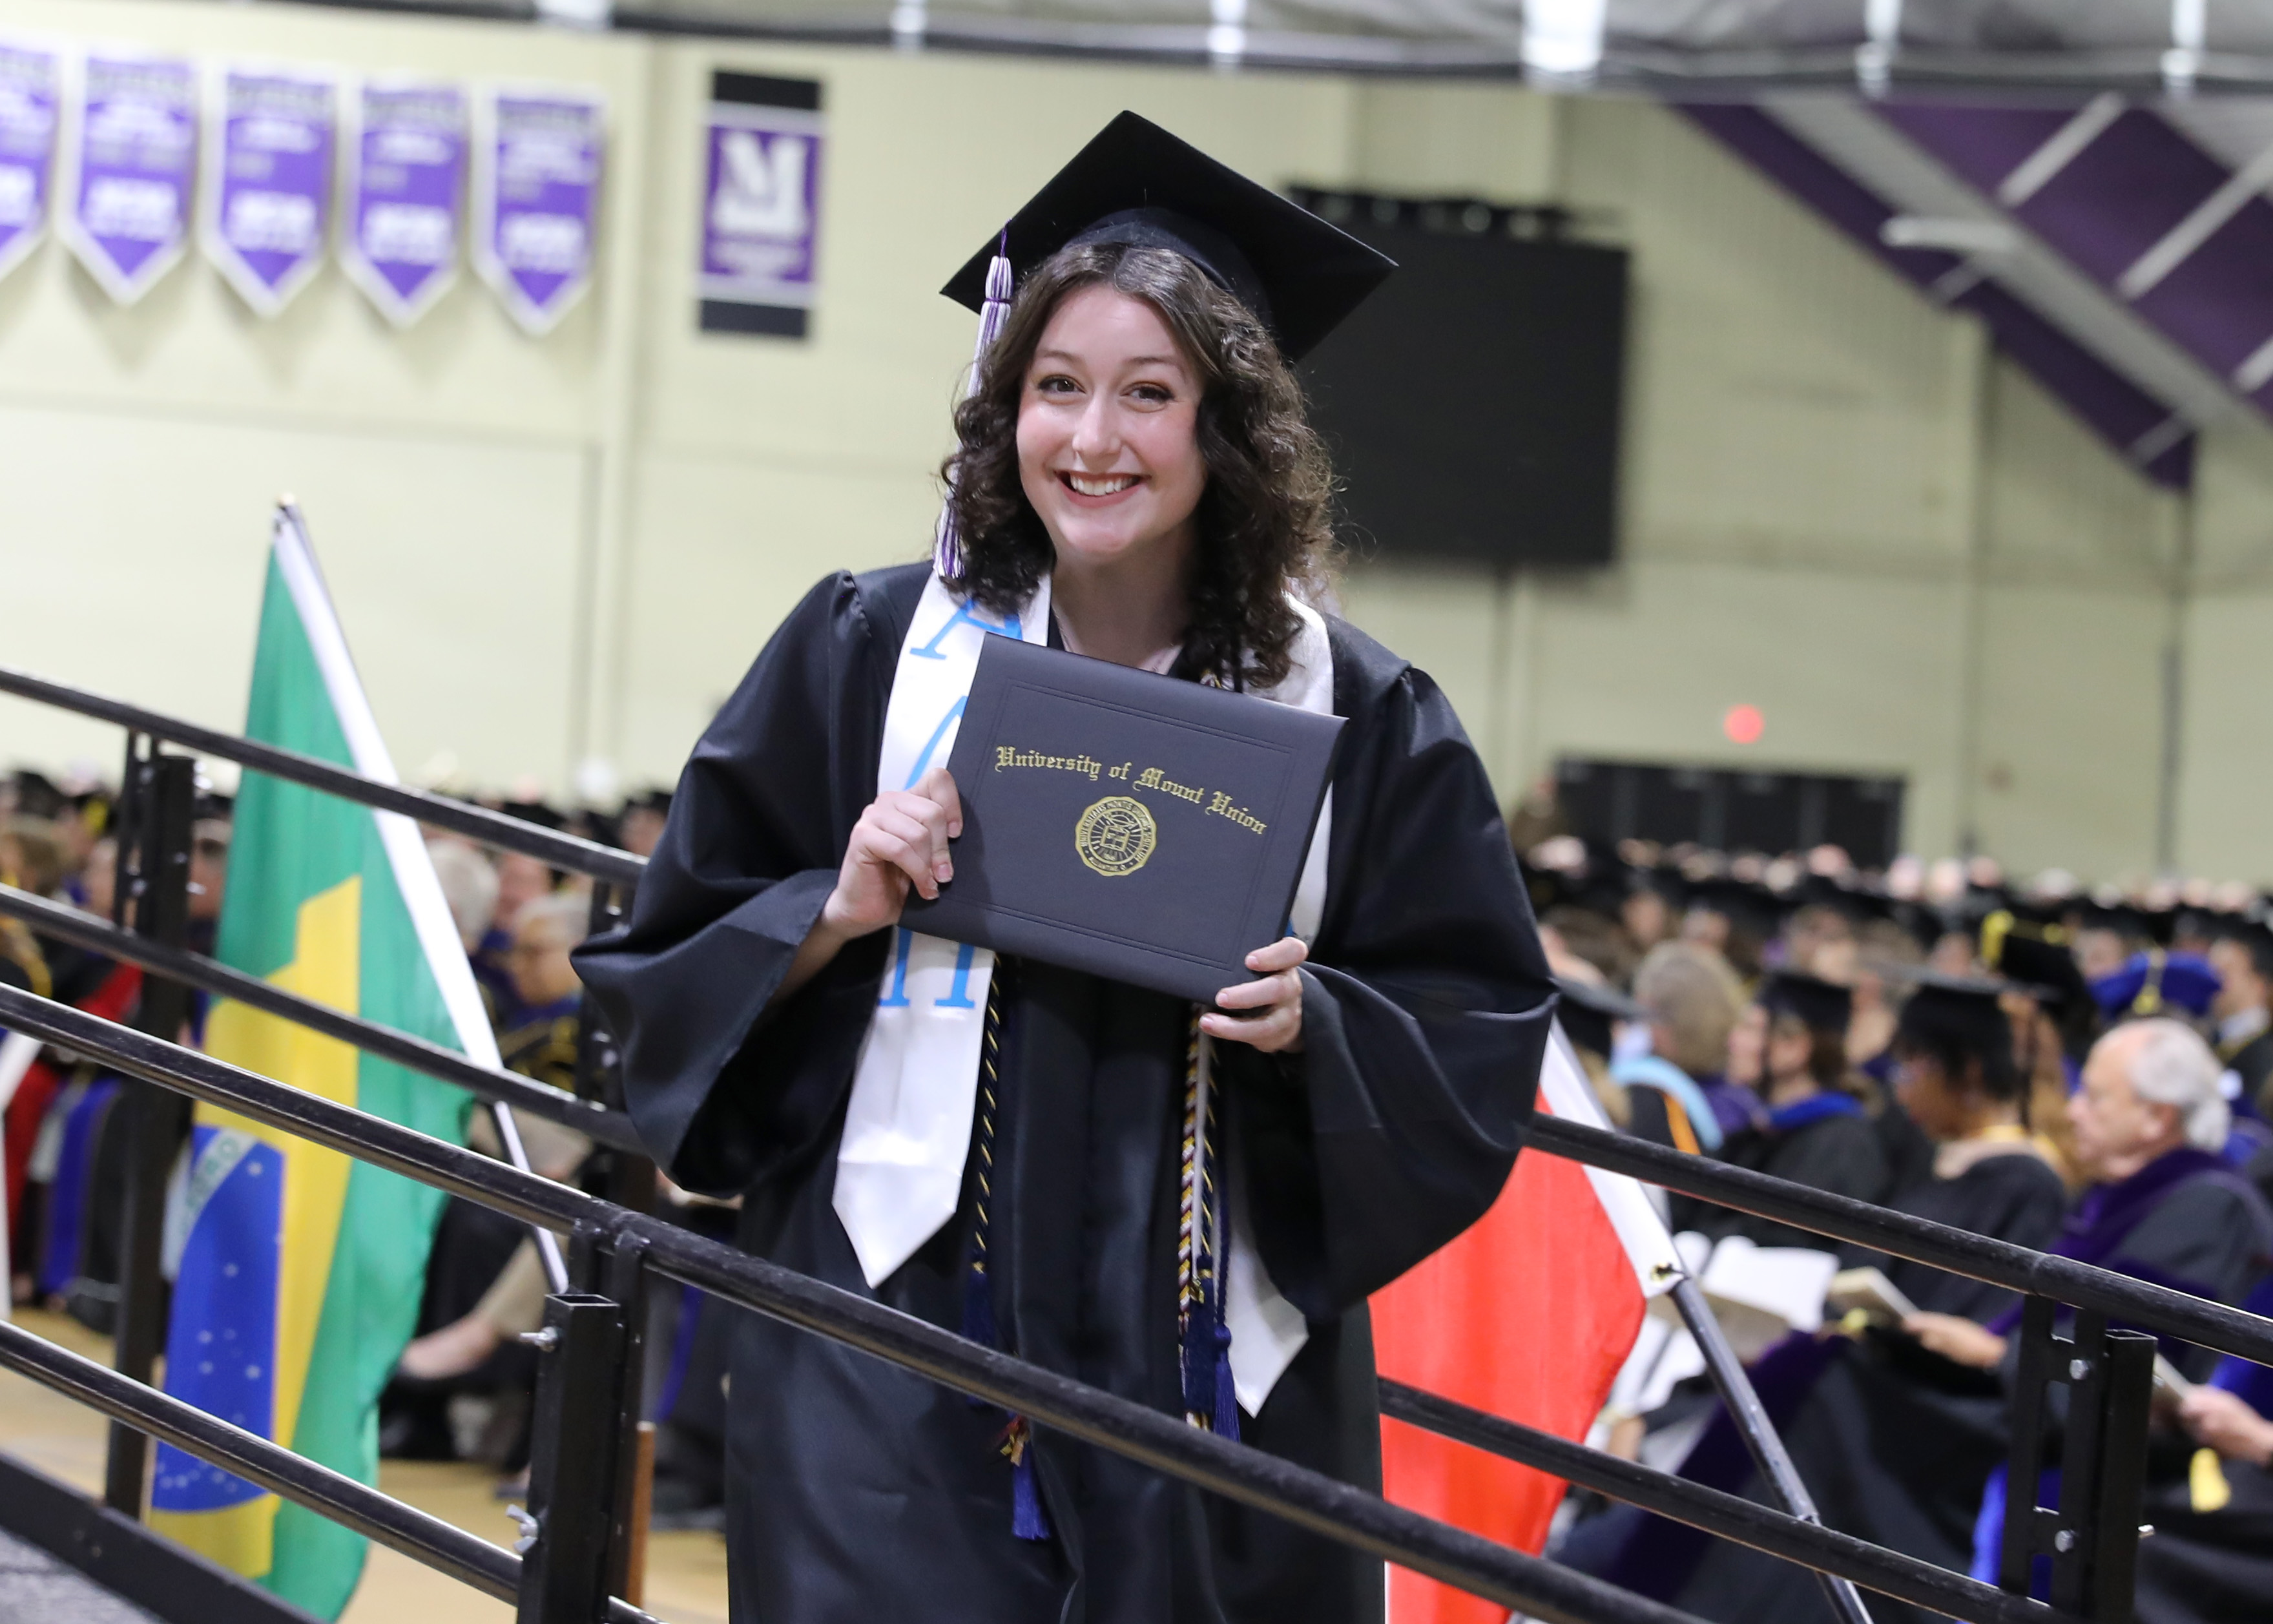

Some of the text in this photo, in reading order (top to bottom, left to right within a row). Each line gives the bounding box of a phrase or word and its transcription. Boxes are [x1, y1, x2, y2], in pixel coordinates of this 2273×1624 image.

[995, 745, 1267, 835] University of Mount Union
